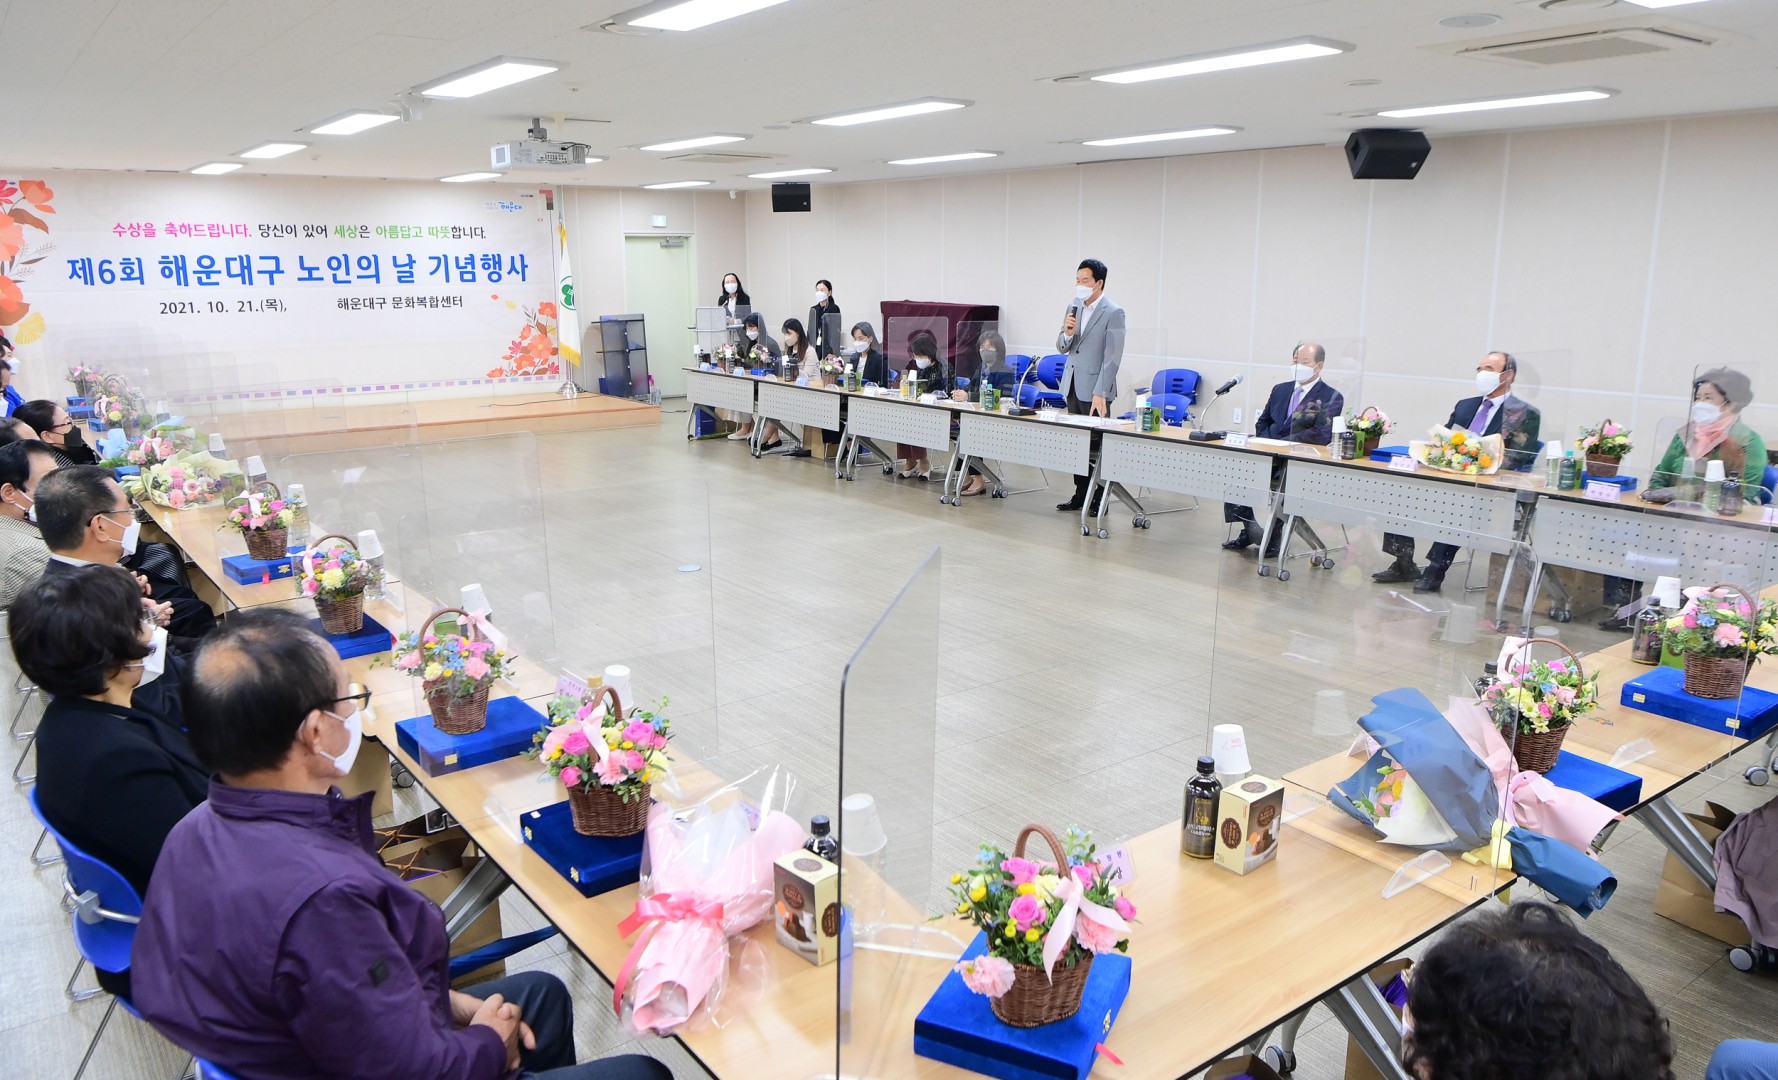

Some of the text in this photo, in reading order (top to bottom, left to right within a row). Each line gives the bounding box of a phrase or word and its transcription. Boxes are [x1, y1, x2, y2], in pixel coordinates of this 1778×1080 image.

[112, 222, 487, 240] 수상을 축하드립니다. 당신이 있어 세상은 아름답고 따뜻합니다.
[67, 253, 529, 287] 제6회 해운대구 노인의 날 기념행사
[159, 298, 288, 315] 2021. 10. 21.(목),
[336, 295, 464, 311] 해운대구 문화복합센터
